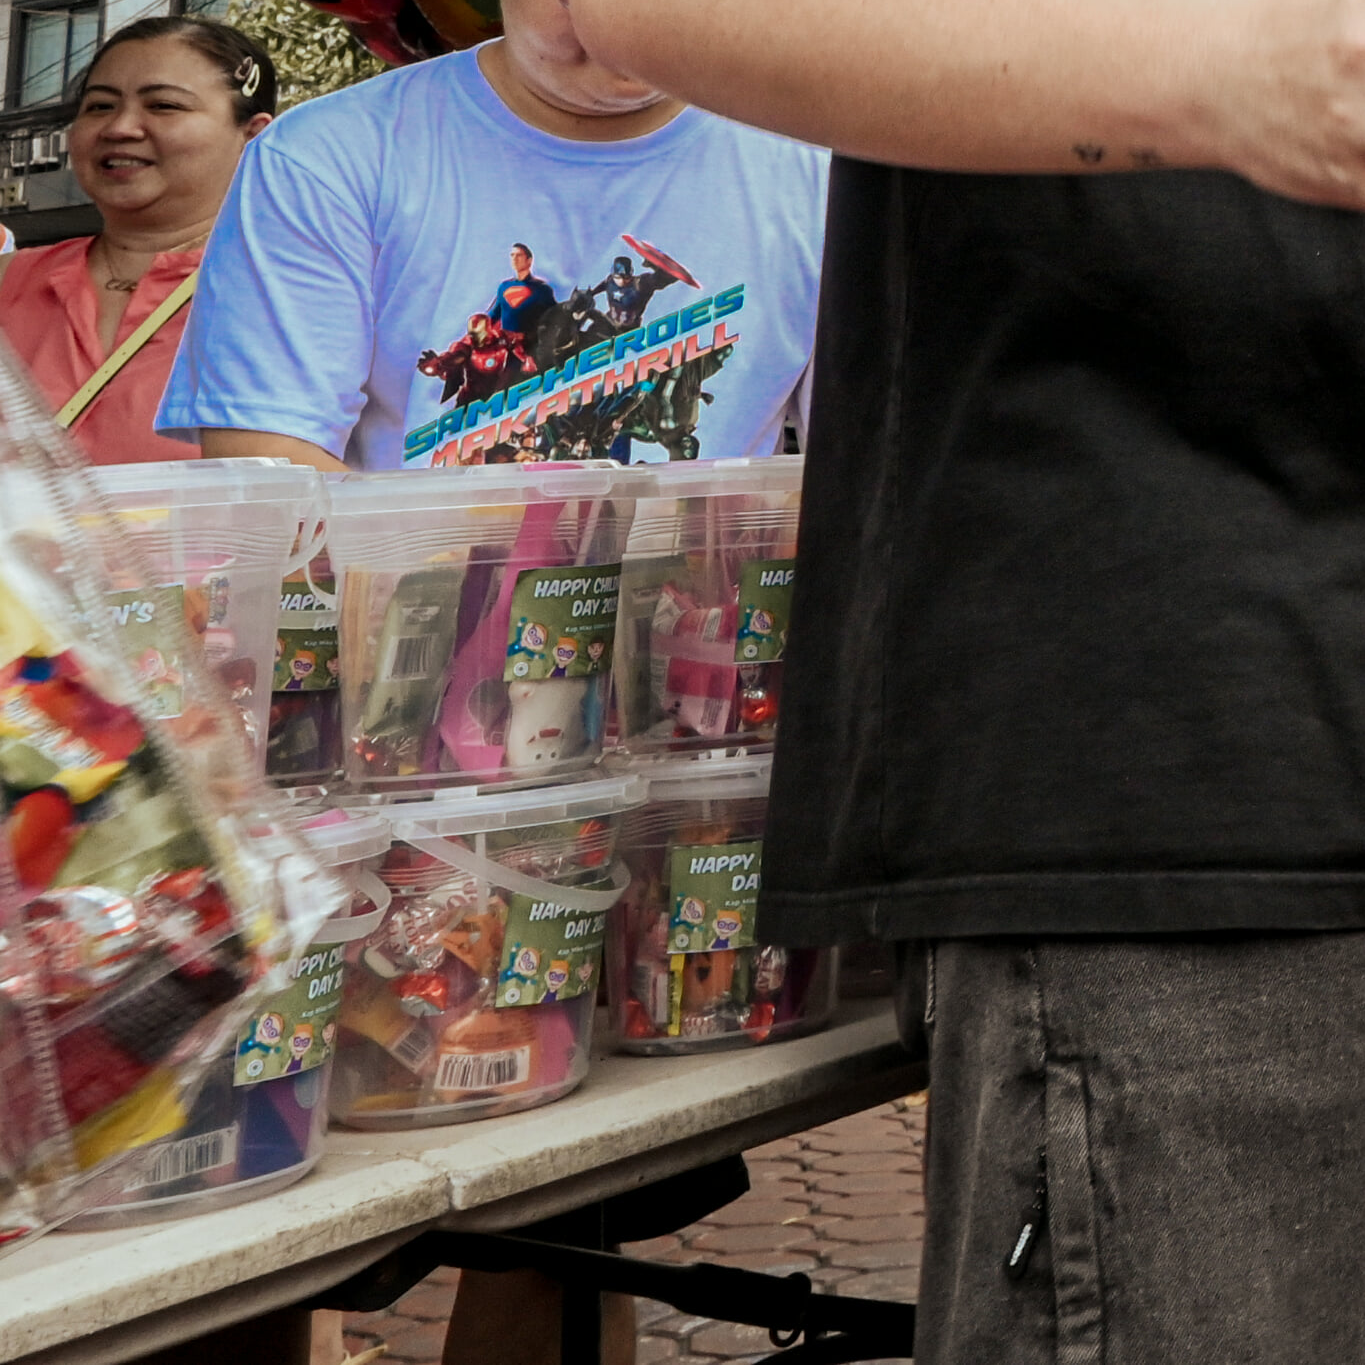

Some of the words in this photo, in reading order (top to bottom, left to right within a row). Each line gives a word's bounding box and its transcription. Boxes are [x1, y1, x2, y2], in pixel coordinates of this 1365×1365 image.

[403, 283, 745, 461] SAMPHEROES
[431, 321, 740, 468] MAKATHRILL
[534, 578, 592, 598] HAPPY
[572, 598, 601, 617] DAY
[690, 853, 755, 874] HAPPY
[565, 917, 592, 939] DAY
[308, 972, 334, 1000] DAY
